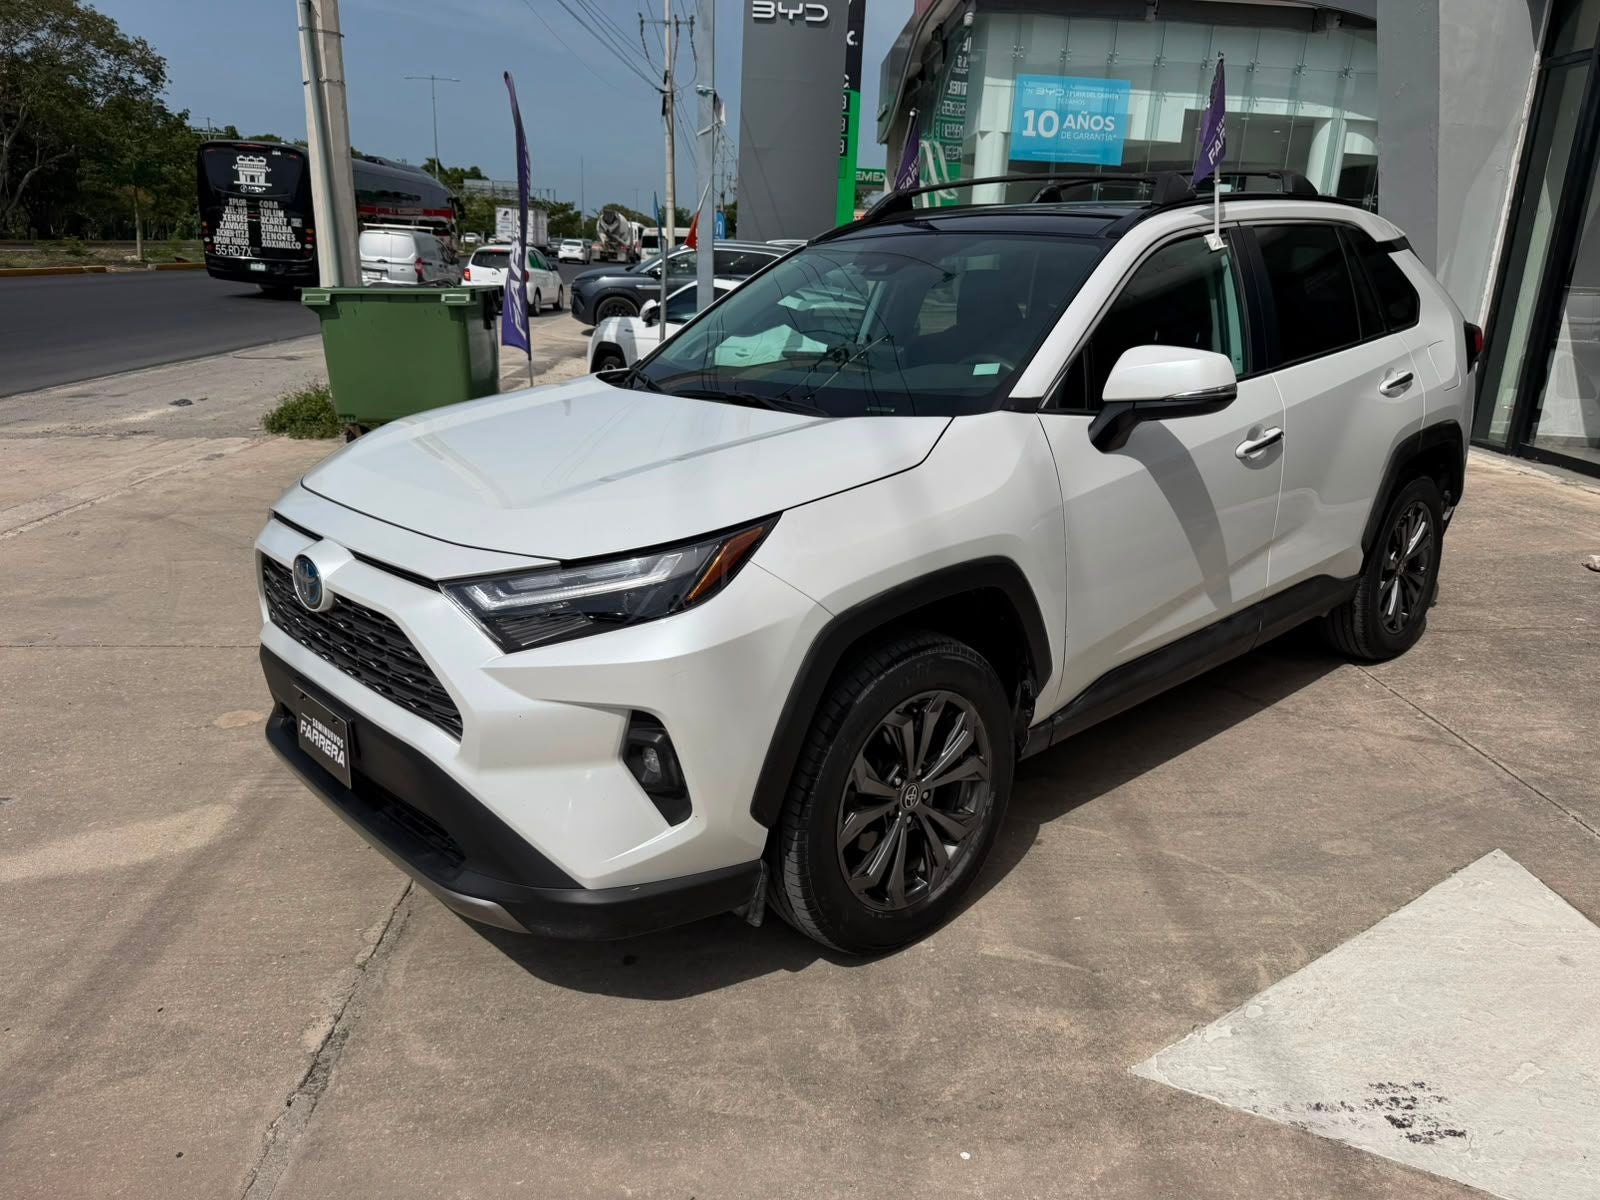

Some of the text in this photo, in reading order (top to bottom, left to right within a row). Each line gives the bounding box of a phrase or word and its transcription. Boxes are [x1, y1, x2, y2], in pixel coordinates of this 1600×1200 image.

[752, 0, 829, 22] BYD
[1022, 109, 1116, 138] 10 AÑOS
[1060, 131, 1072, 140] DE
[260, 208, 285, 218] TULUM
[219, 221, 249, 231] XAVAGE
[260, 216, 288, 226] XCARET
[261, 224, 293, 234] XIBALBA
[261, 240, 302, 250] XOXIMILCO
[312, 717, 344, 749] SEMINUEVOS
[300, 719, 346, 769] FARRERA
